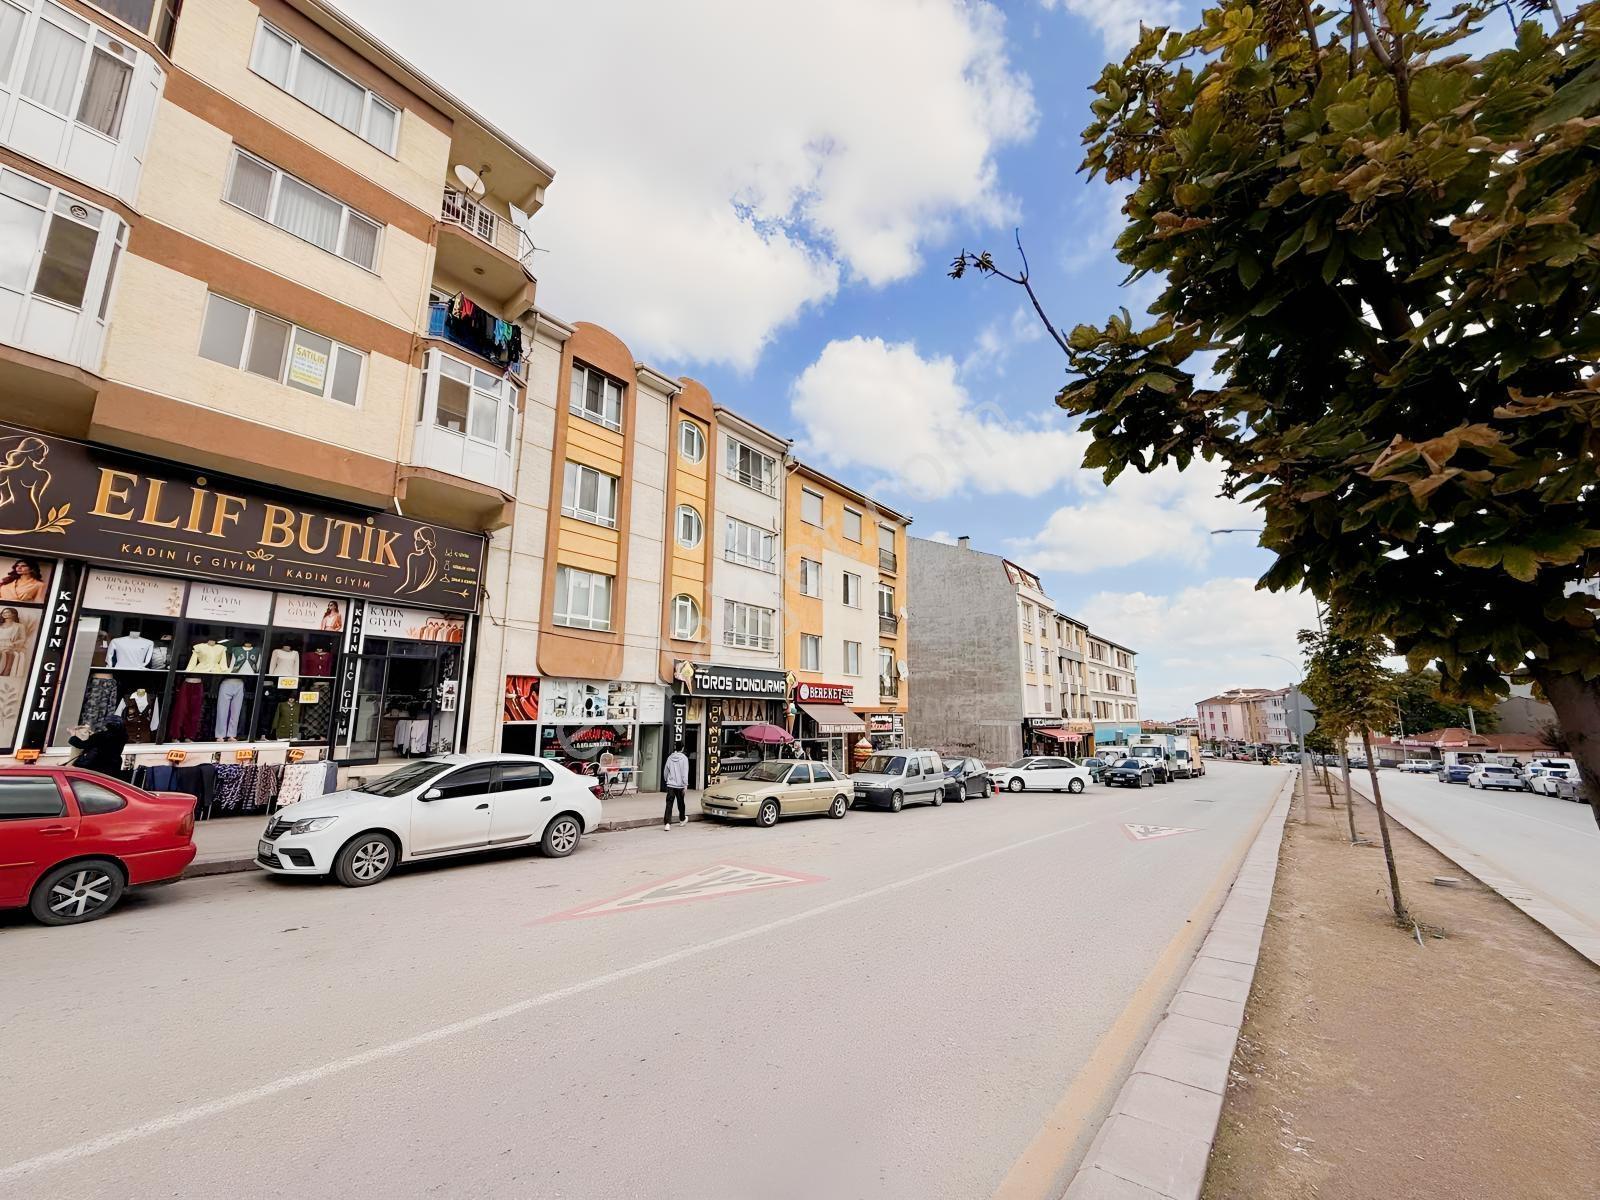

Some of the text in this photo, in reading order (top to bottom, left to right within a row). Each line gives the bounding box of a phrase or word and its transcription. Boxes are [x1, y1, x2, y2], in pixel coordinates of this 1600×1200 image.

[296, 347, 325, 364] SATILIK
[87, 467, 403, 568] ELİF BUTİK
[121, 543, 256, 572] KADIN İÇ GİYİM
[286, 568, 370, 589] KADIN GİYİM
[370, 607, 404, 618] KADIN
[350, 608, 362, 652] KADIN
[31, 591, 72, 721] KADIN GİYİM
[695, 674, 786, 693] TOROS DONDURMA
[809, 686, 842, 700] BEREKET
